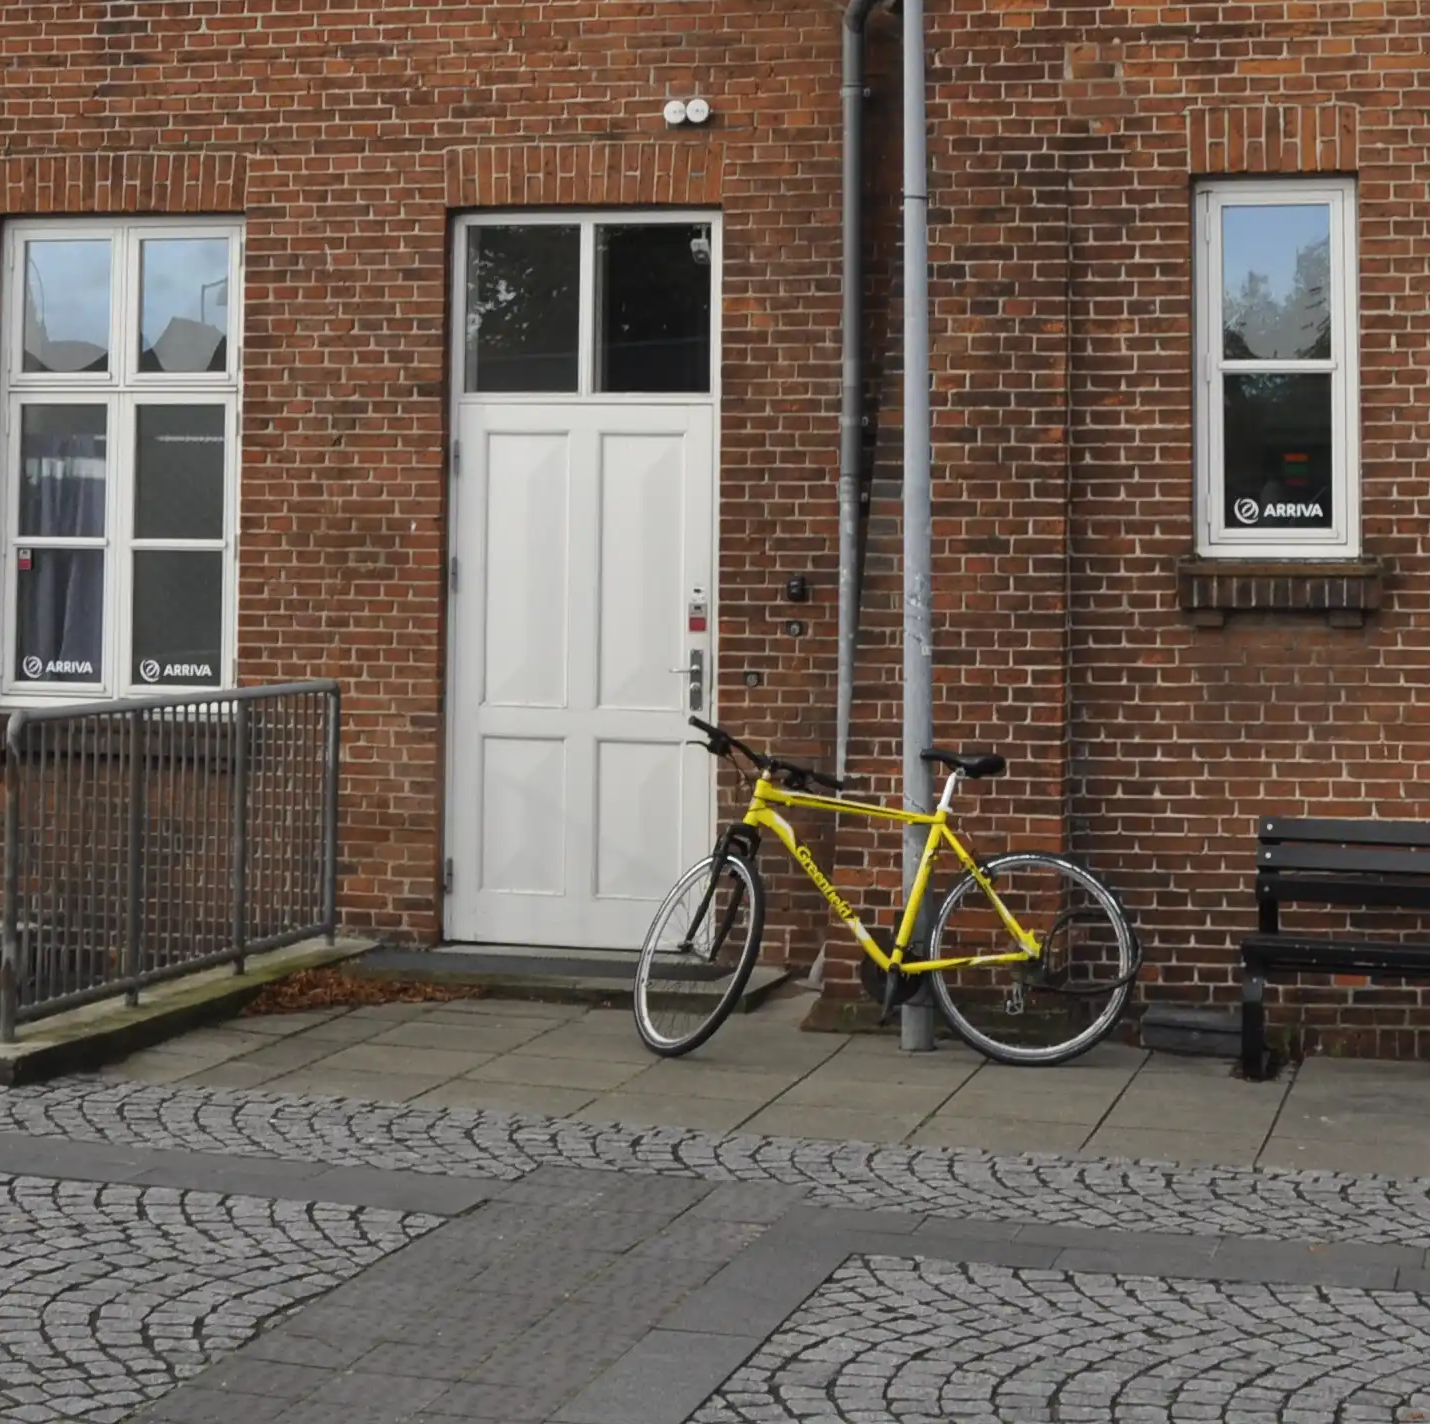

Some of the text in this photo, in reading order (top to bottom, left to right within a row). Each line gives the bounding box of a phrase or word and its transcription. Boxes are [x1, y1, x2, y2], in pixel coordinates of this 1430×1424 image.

[1263, 502, 1323, 518] ARRIVA
[45, 660, 93, 674] ARRIVA
[163, 664, 212, 677] ARRIVA
